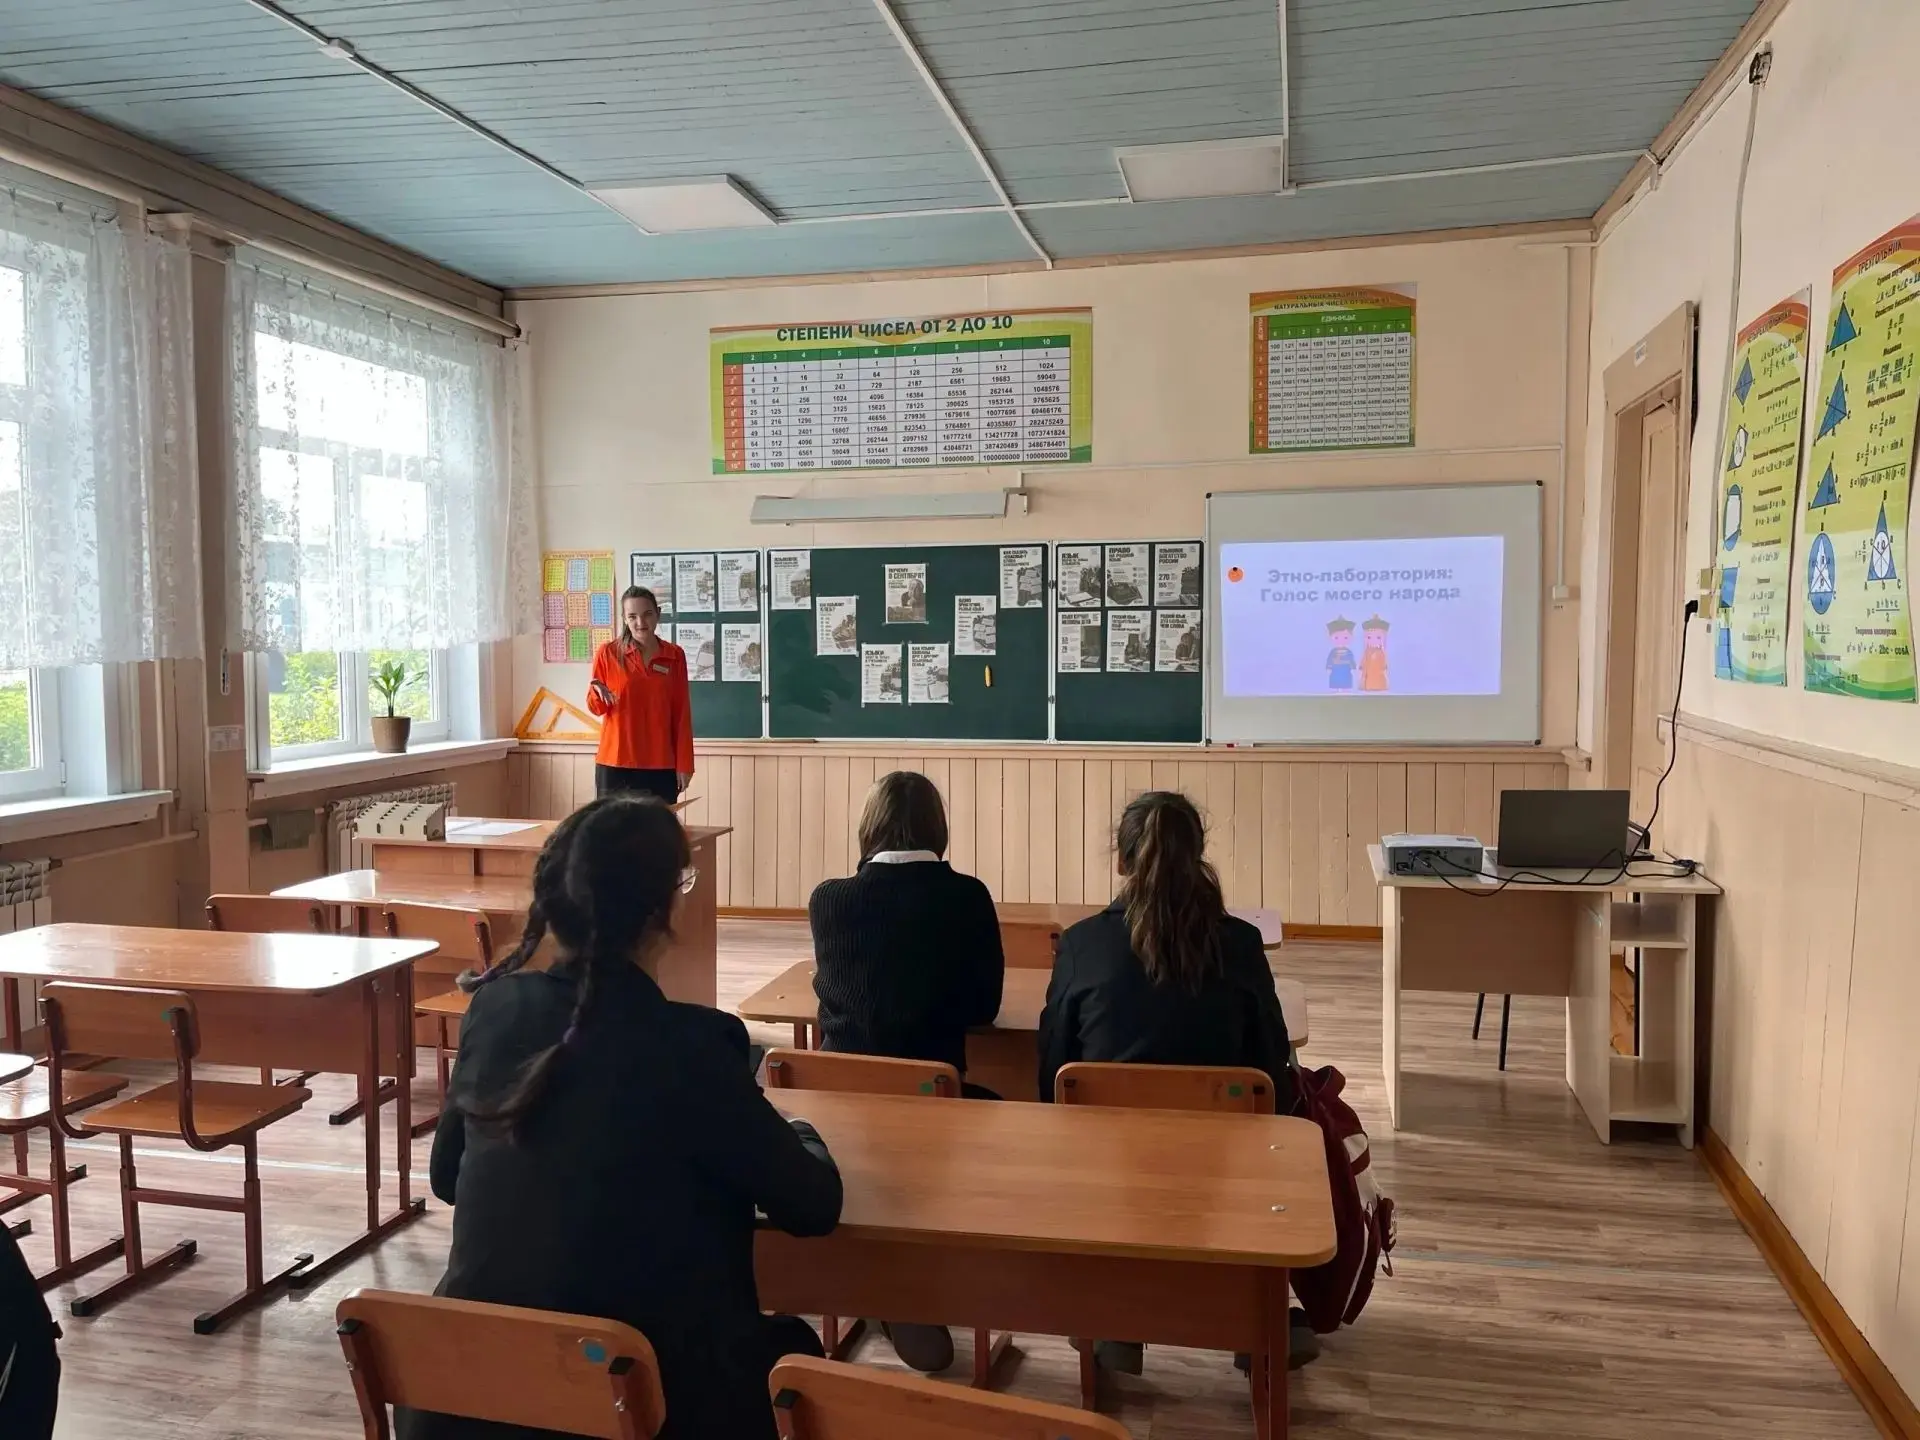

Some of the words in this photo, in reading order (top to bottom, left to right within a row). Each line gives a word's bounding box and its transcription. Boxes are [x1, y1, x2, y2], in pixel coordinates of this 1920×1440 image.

[1274, 301, 1324, 310] НАТУРАЛЬНЫХ
[777, 325, 853, 342] СТЕПЕНИ
[859, 320, 915, 338] ЧИСЕЛ
[921, 319, 941, 333] ОТ
[946, 318, 956, 332] 2
[961, 317, 986, 334] ДО
[992, 315, 1013, 329] 10
[1158, 573, 1170, 581] 270
[1268, 567, 1453, 585] Этно-лаборатория:
[1261, 588, 1318, 602] Голос
[1325, 588, 1383, 602] моего
[1389, 586, 1461, 603] народа
